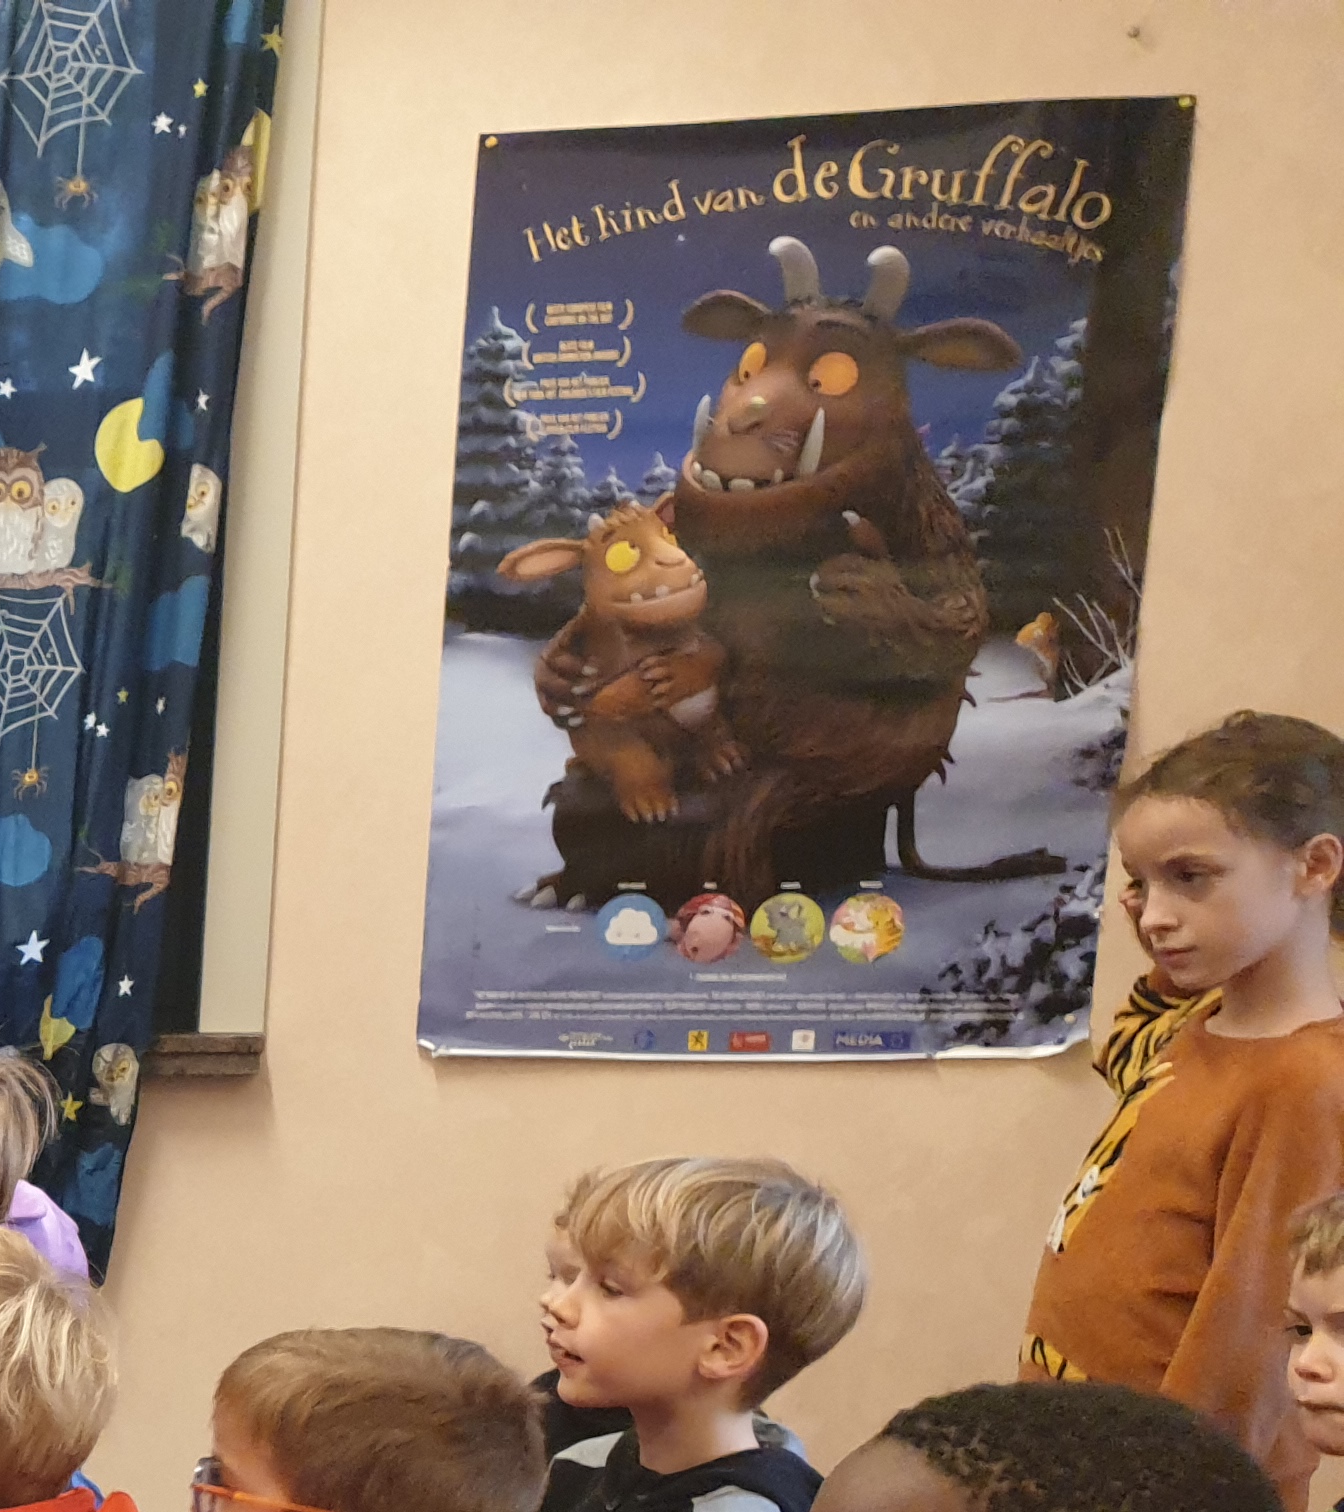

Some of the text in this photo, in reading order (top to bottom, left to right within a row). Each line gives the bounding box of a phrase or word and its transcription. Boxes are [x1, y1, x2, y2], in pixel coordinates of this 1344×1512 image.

[523, 215, 590, 263] Het
[591, 179, 686, 242] kind
[692, 186, 765, 215] van
[847, 134, 1112, 230] Gruffalo
